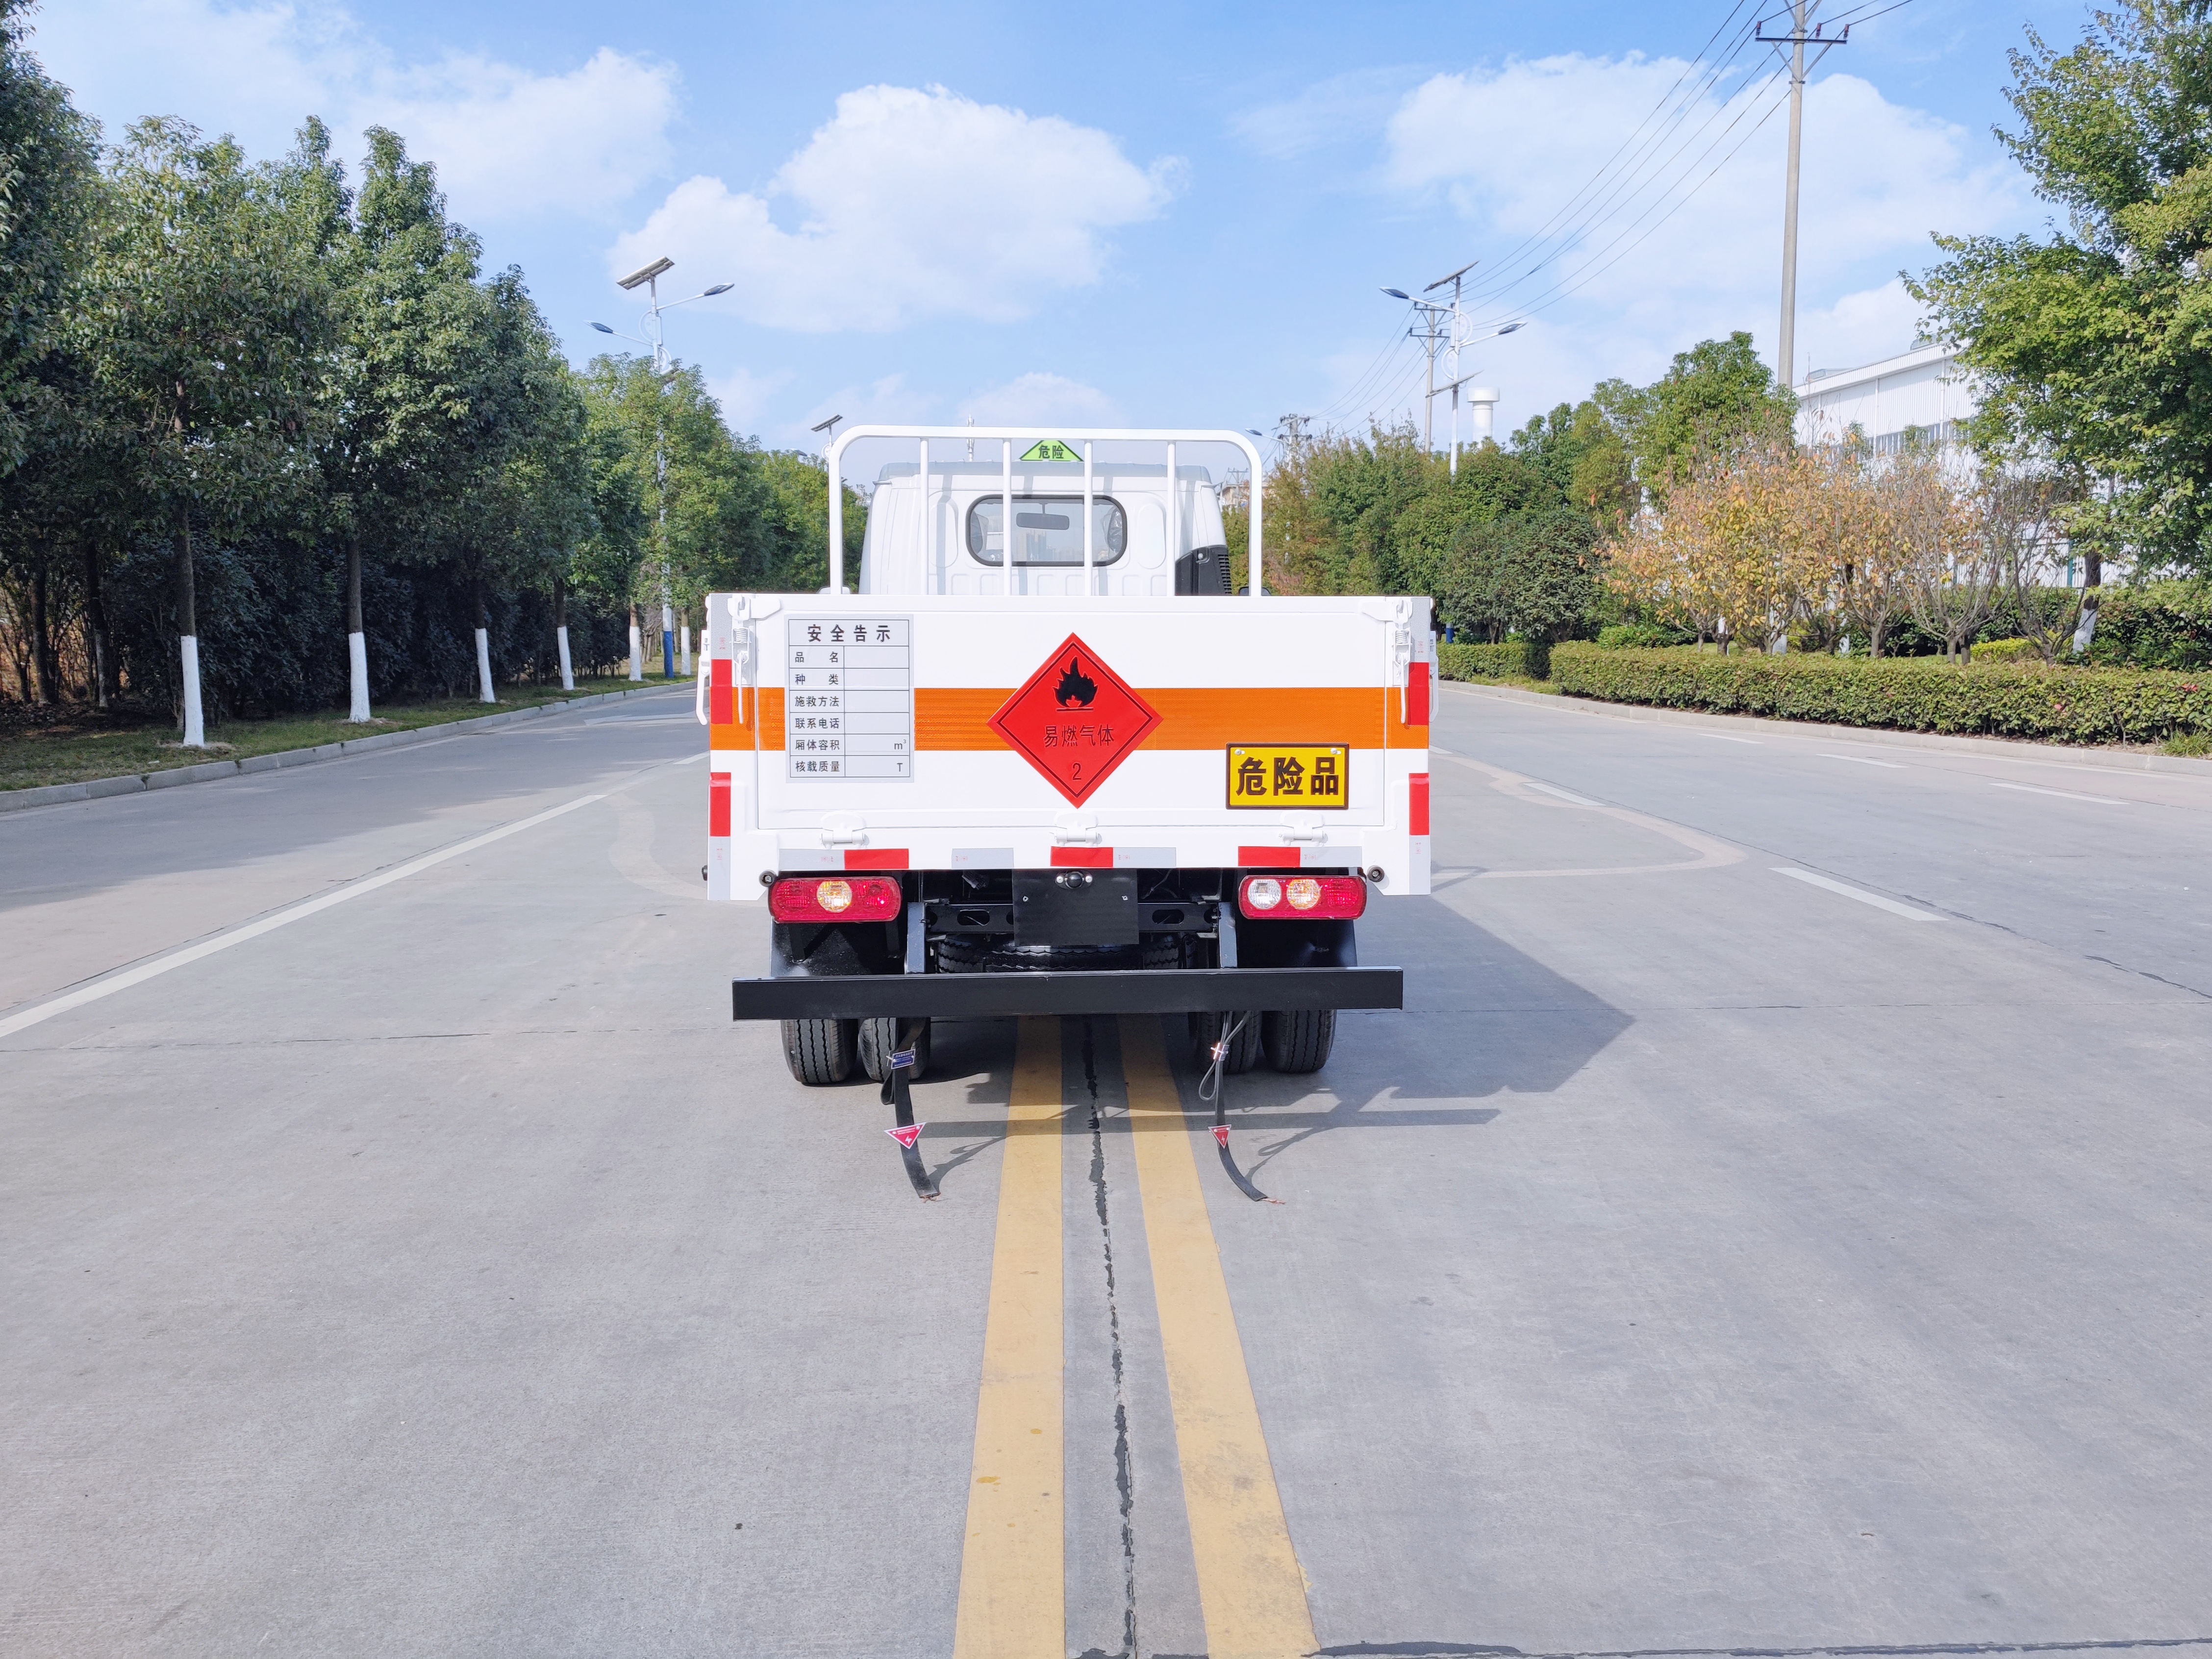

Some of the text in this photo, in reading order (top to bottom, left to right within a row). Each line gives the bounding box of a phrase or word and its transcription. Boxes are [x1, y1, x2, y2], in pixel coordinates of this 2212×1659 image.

[1038, 445, 1064, 459] 危险
[807, 624, 890, 642] 安全告示
[795, 696, 839, 707] 施救方法
[795, 718, 839, 729] 联系电话
[1044, 724, 1114, 748] 易燃气体
[795, 739, 840, 751] 厢体容积
[795, 761, 840, 772] 核载质量
[897, 763, 903, 772] T
[1072, 762, 1081, 780] 2
[1235, 756, 1339, 796] 危险品
